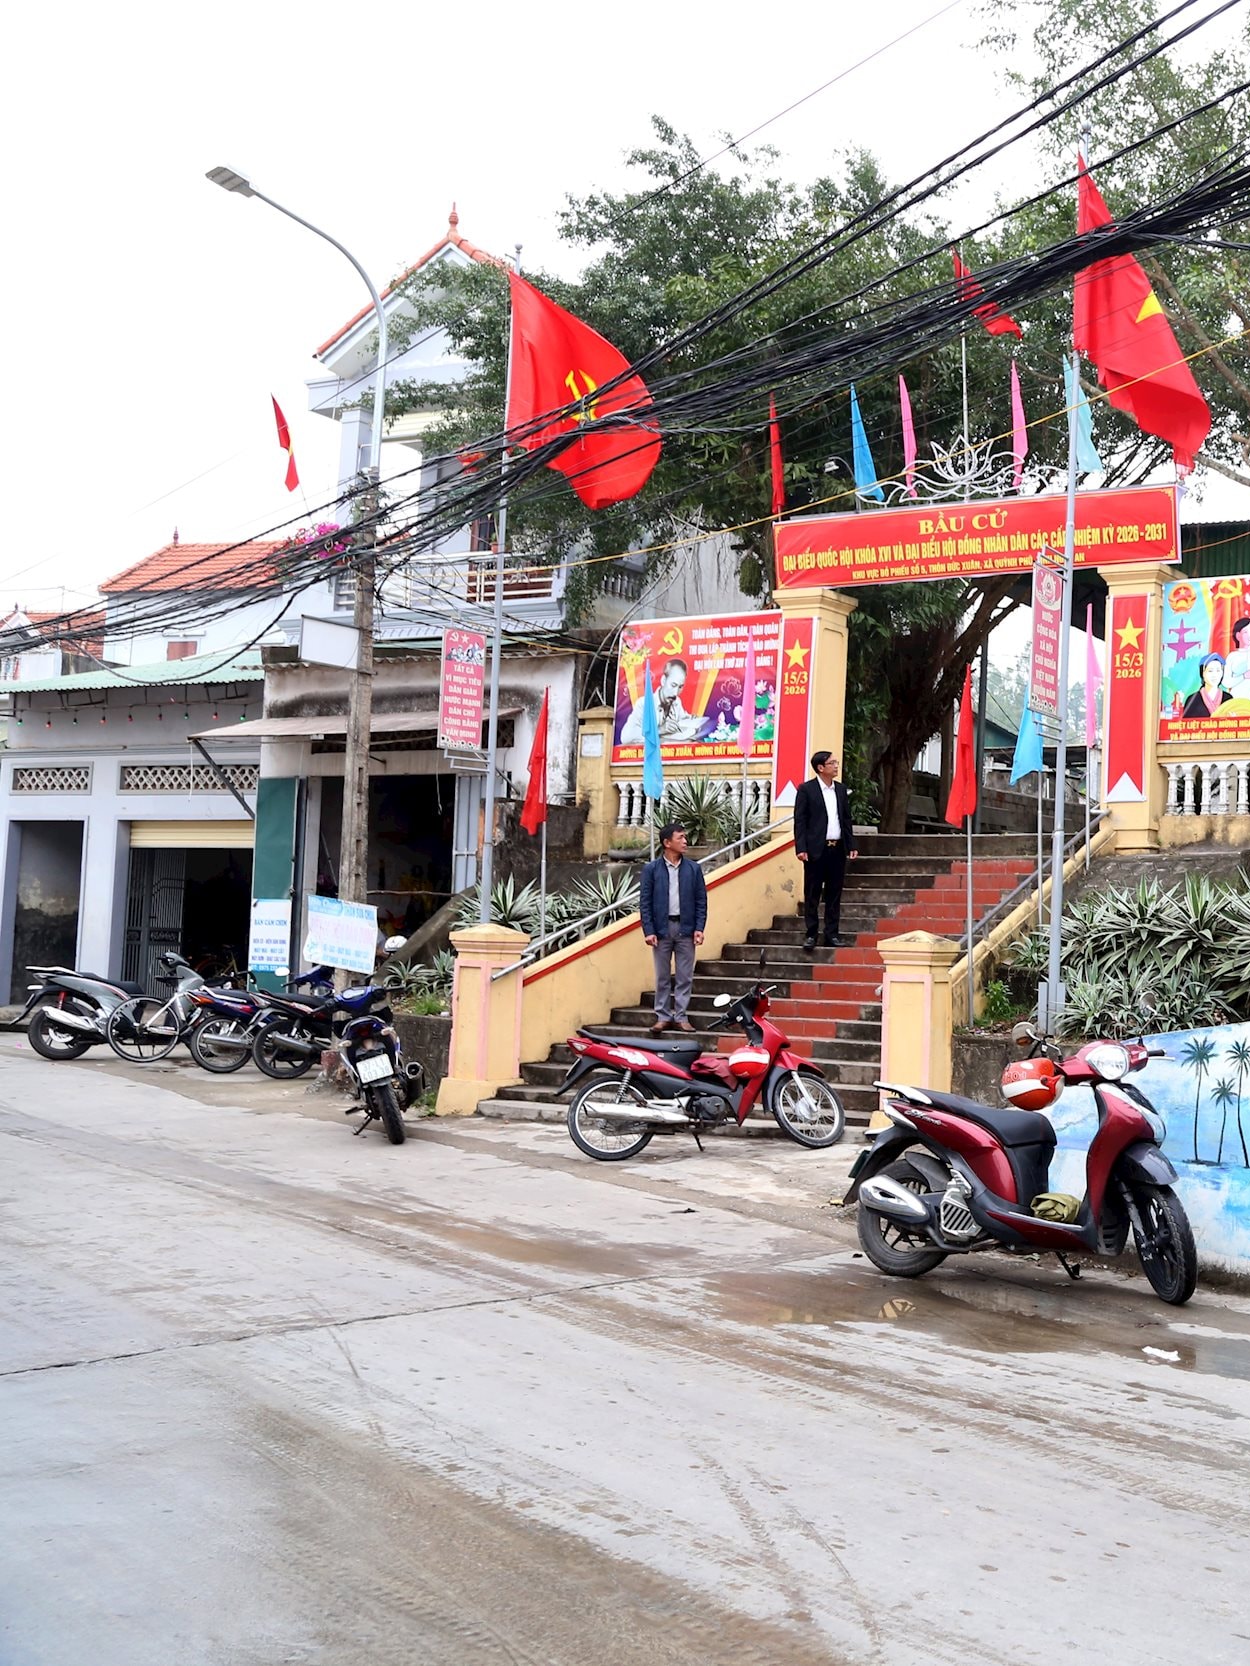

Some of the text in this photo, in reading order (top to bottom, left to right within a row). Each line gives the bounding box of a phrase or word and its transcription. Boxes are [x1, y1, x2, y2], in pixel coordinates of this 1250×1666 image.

[918, 507, 1008, 535] BẦU CỬ
[783, 554, 796, 574] ĐẠI
[798, 546, 816, 570] BIỂU
[817, 545, 838, 570] QUỐC
[840, 546, 854, 568] HỘI
[854, 544, 876, 565] KHÓA
[878, 545, 892, 563] XVI
[893, 541, 905, 561] VÀ
[906, 543, 920, 563] ĐẠI
[921, 535, 940, 559] BIỂU
[942, 536, 956, 560] HỘI
[958, 533, 982, 555] ĐỒNG
[984, 533, 1008, 554] NHÂN
[1010, 531, 1028, 551] DÂN
[1030, 529, 1048, 550] CÁC
[1102, 522, 1114, 544] KỲ
[1115, 652, 1144, 668] 15/3
[784, 671, 808, 685] 15/3
[1116, 669, 1142, 678] 2026
[784, 686, 806, 695] 2026
